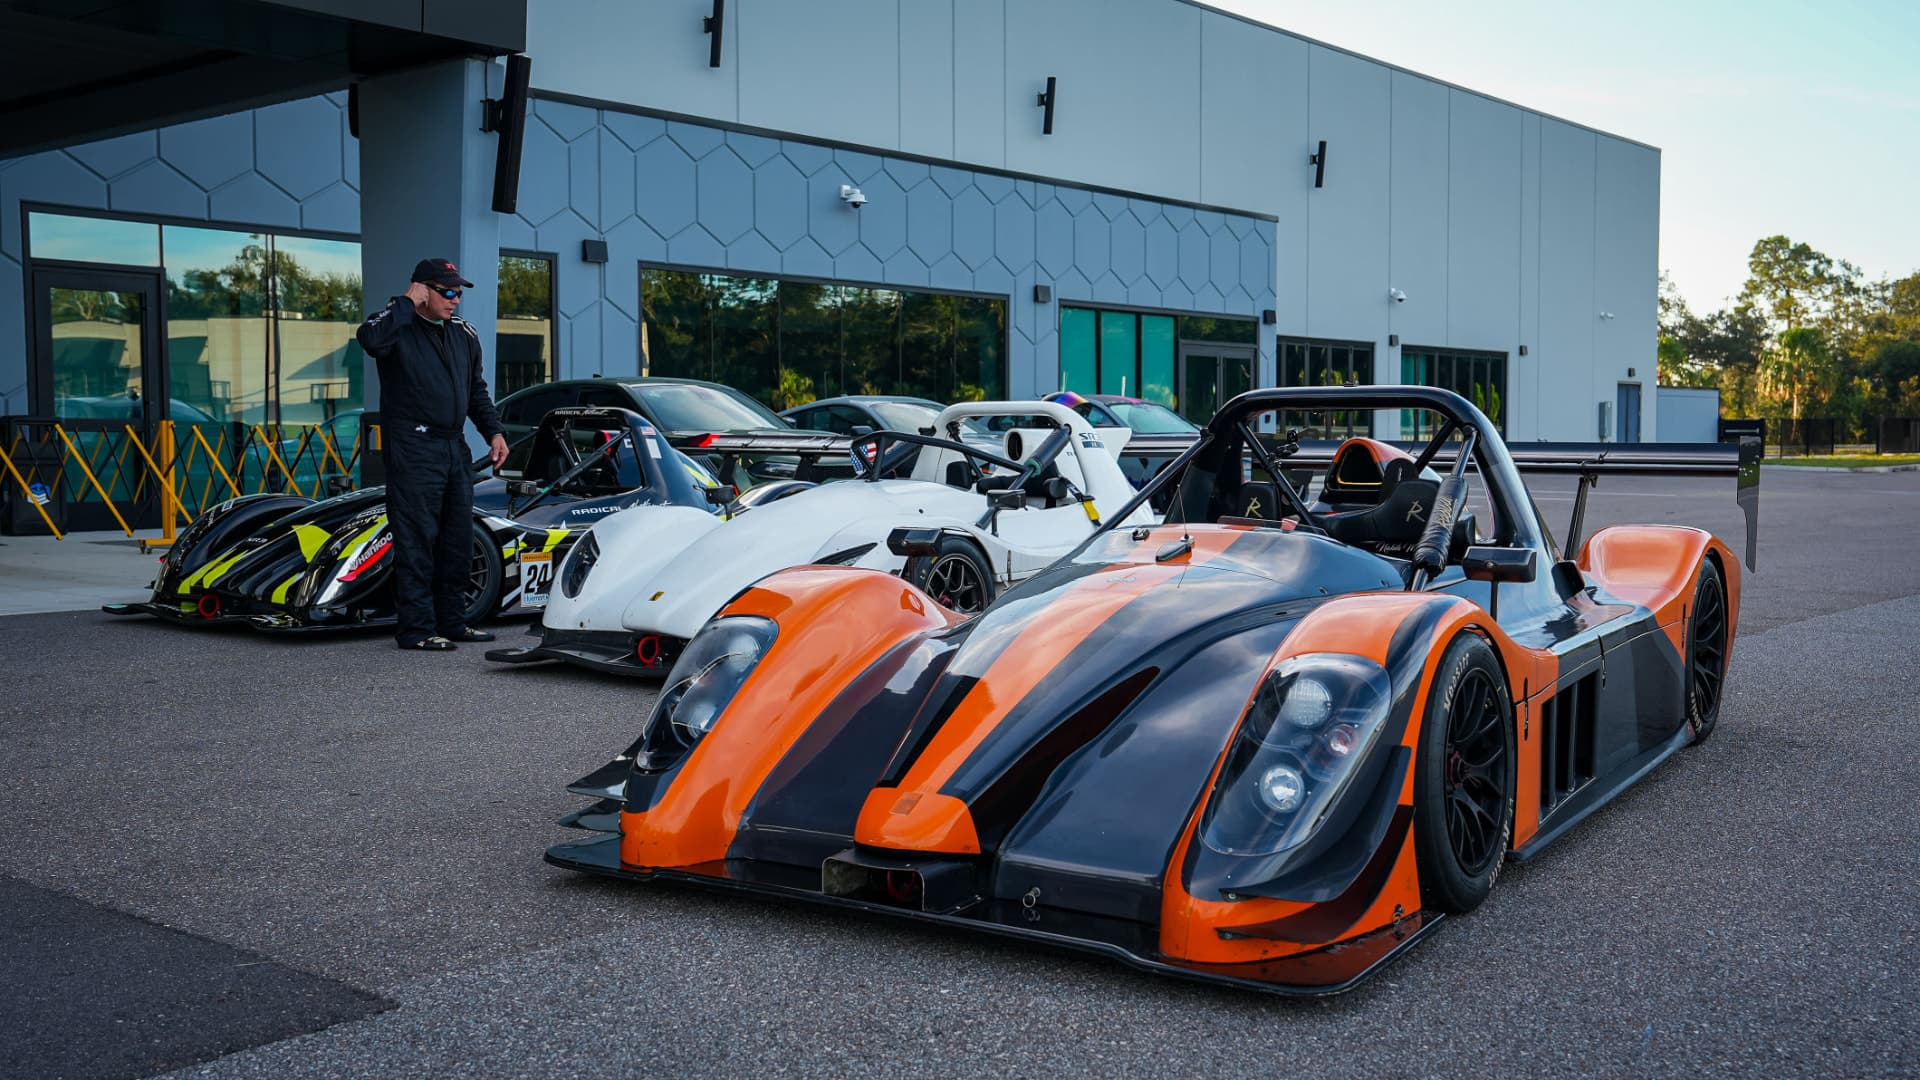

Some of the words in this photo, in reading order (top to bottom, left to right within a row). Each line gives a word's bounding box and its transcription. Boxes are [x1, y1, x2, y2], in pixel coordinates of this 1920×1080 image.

[1244, 497, 1263, 518] R
[1406, 501, 1425, 522] R
[359, 531, 394, 563] Hankoo
[524, 563, 555, 594] 24
